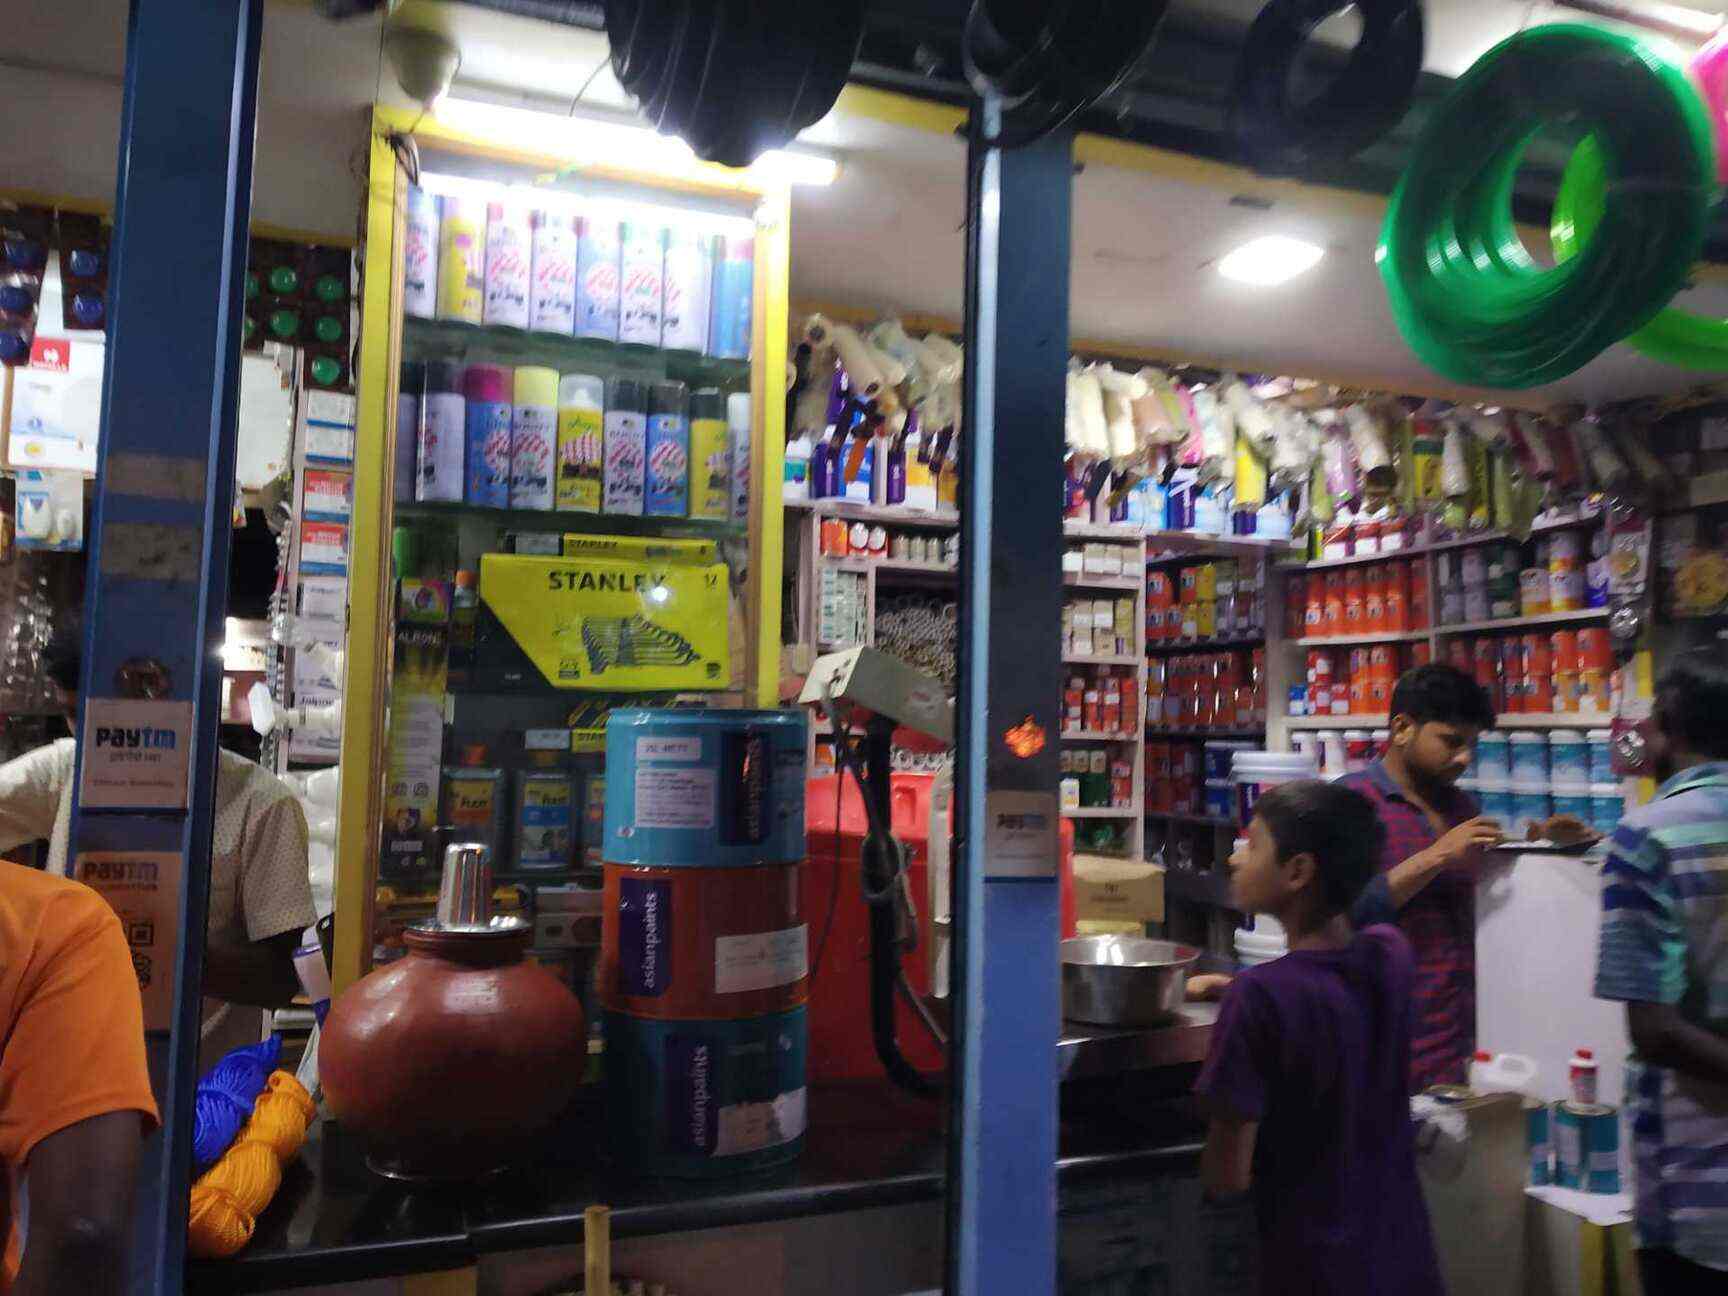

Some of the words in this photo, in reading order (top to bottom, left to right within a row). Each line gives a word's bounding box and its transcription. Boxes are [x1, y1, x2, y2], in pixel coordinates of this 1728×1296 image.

[548, 570, 667, 593] STANLEY
[641, 891, 660, 989] asianpaints
[692, 1044, 711, 1147] asianpaints
